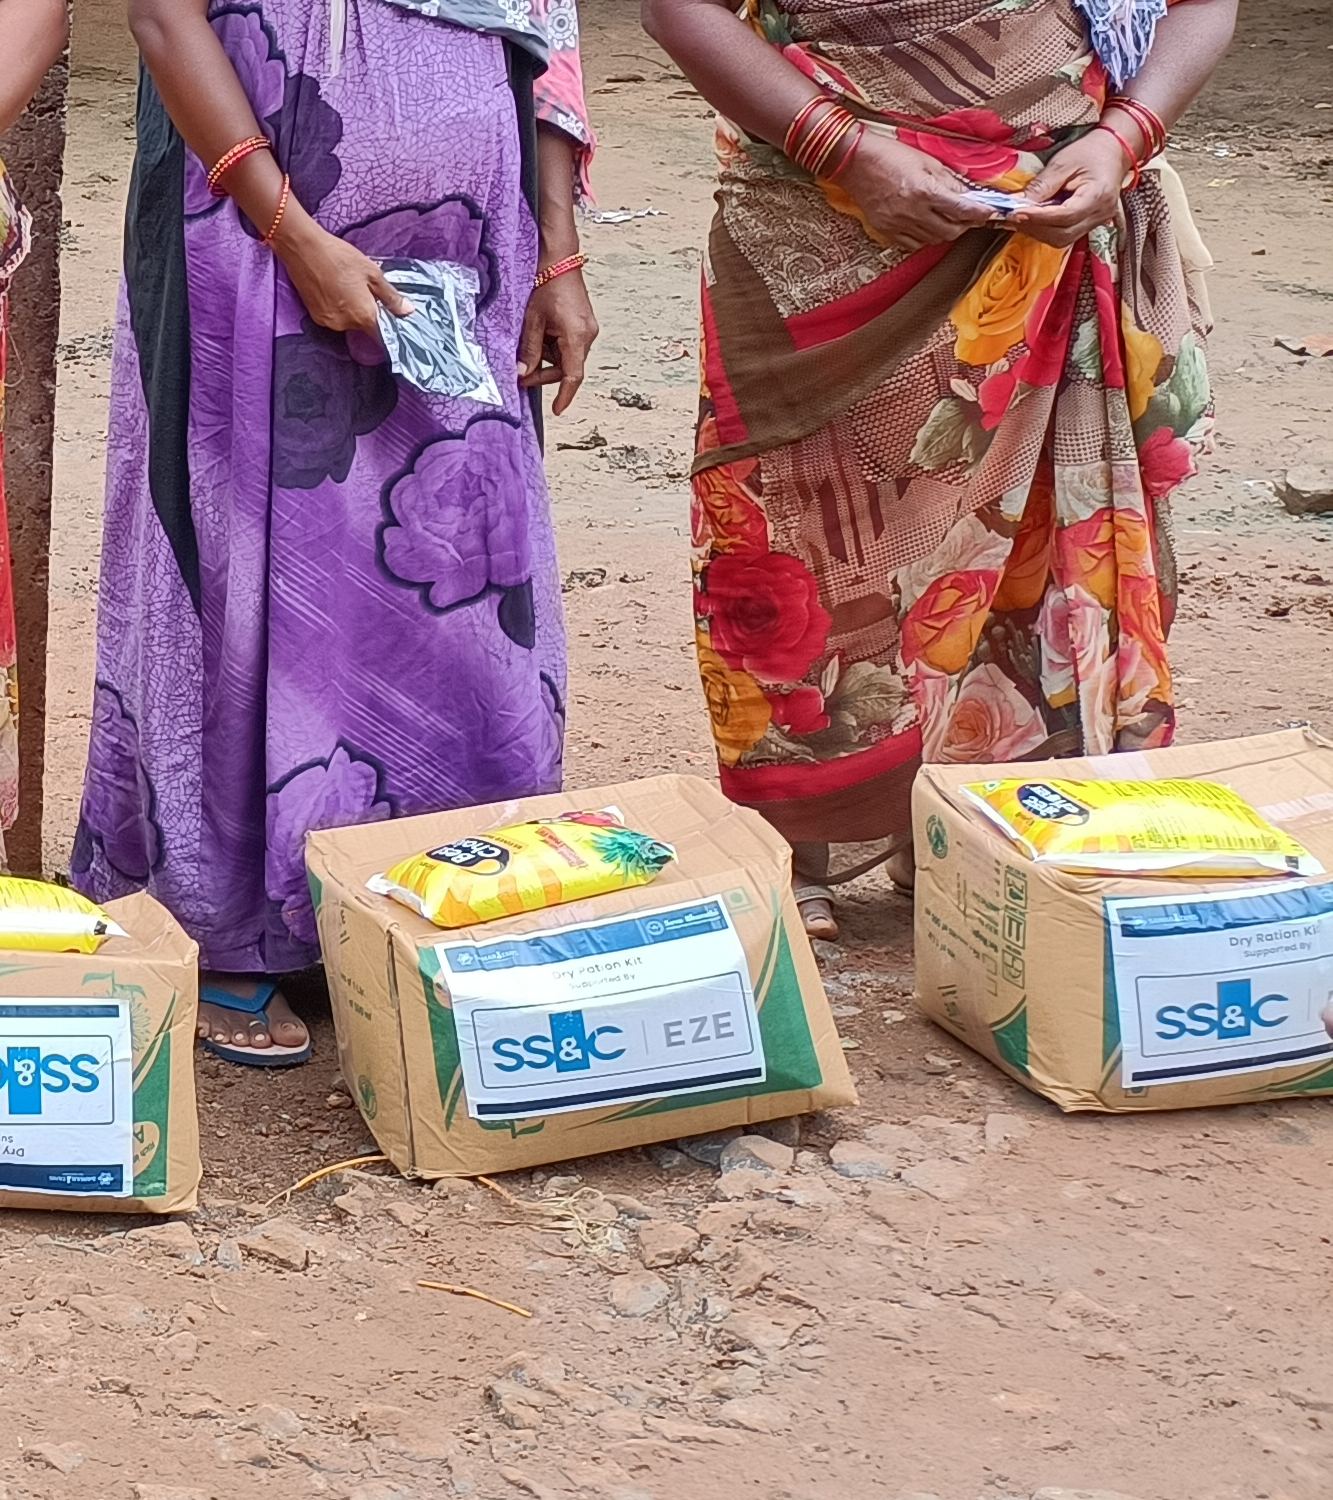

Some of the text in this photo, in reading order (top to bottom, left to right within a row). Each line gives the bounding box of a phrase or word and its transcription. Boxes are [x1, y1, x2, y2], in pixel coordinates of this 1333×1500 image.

[1229, 935, 1253, 948] Dry
[1256, 928, 1301, 943] Ration
[624, 956, 643, 968] Kit
[1154, 991, 1289, 1041] SS&C
[491, 1011, 735, 1073] SS&C EZE
[1, 1146, 25, 1158] Dry
